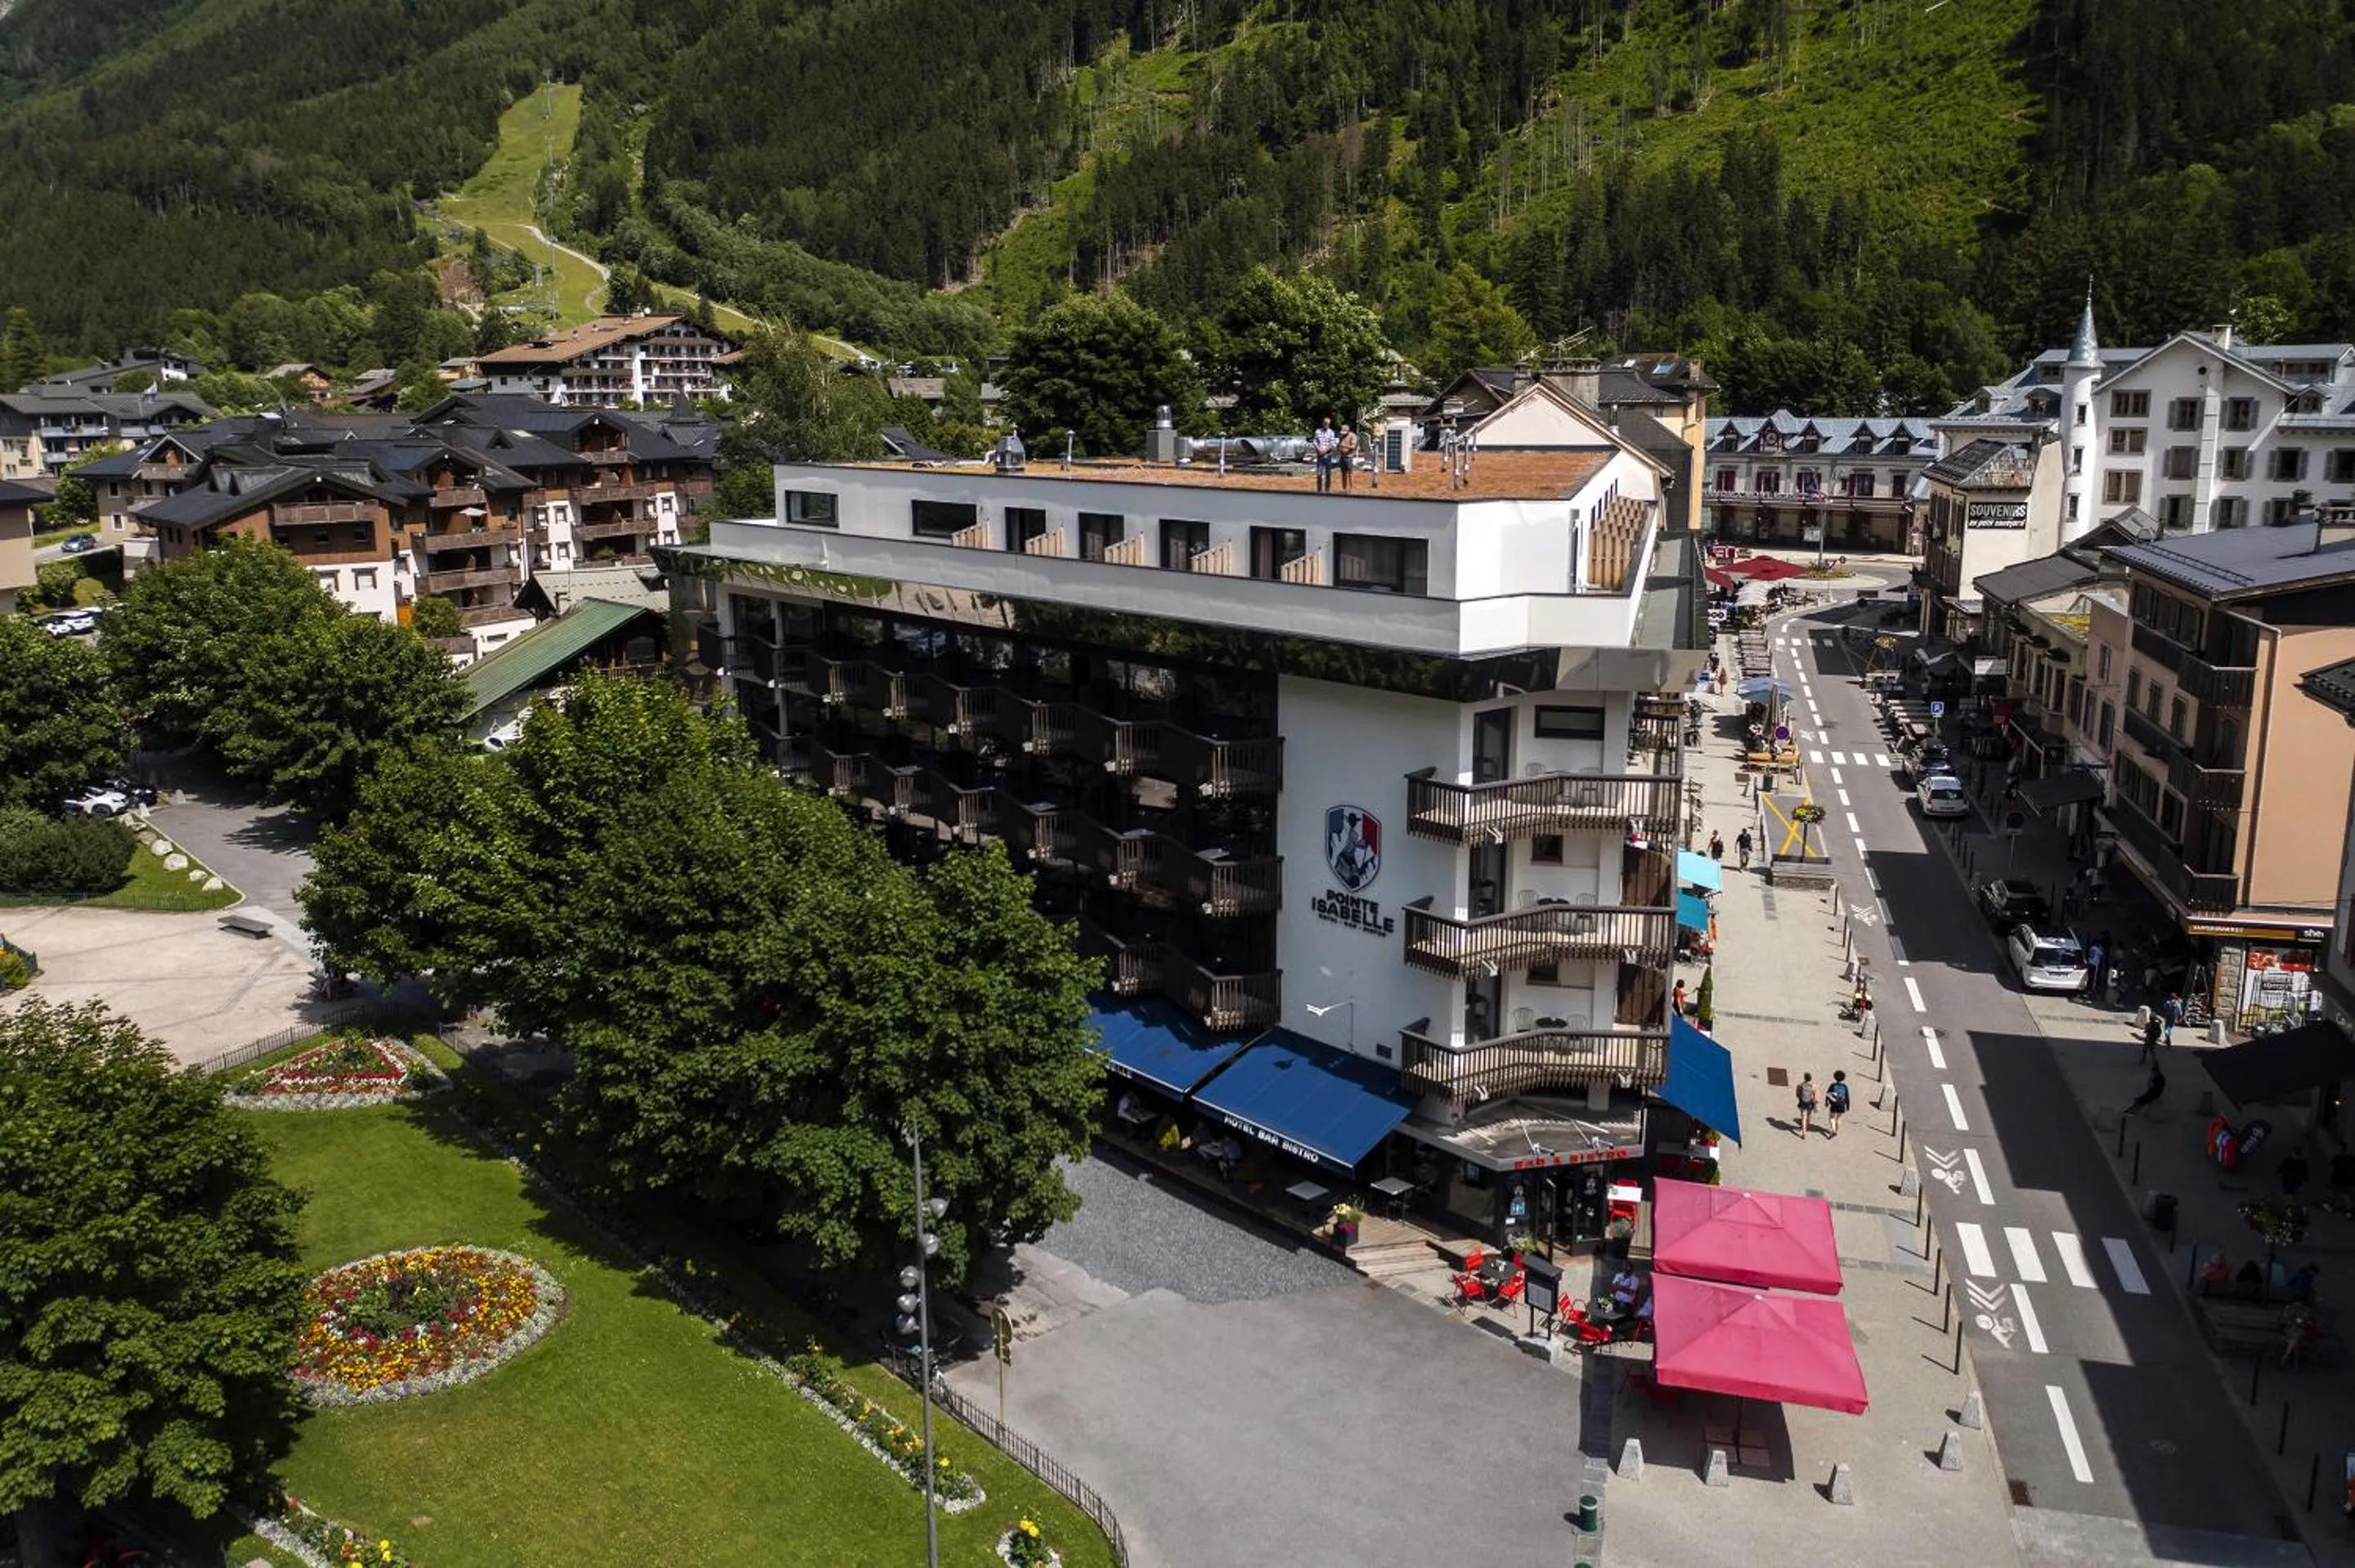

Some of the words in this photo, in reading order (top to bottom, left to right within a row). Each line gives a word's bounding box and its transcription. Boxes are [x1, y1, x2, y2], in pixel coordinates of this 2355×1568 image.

[1969, 504, 2026, 517] SOUVENIRS
[1312, 897, 1394, 933] ISABELLE
[1326, 889, 1379, 914] POINTE
[1224, 1114, 1255, 1136] HOTEL
[1257, 1129, 1280, 1146] BAR
[1281, 1140, 1319, 1163] BISTRO
